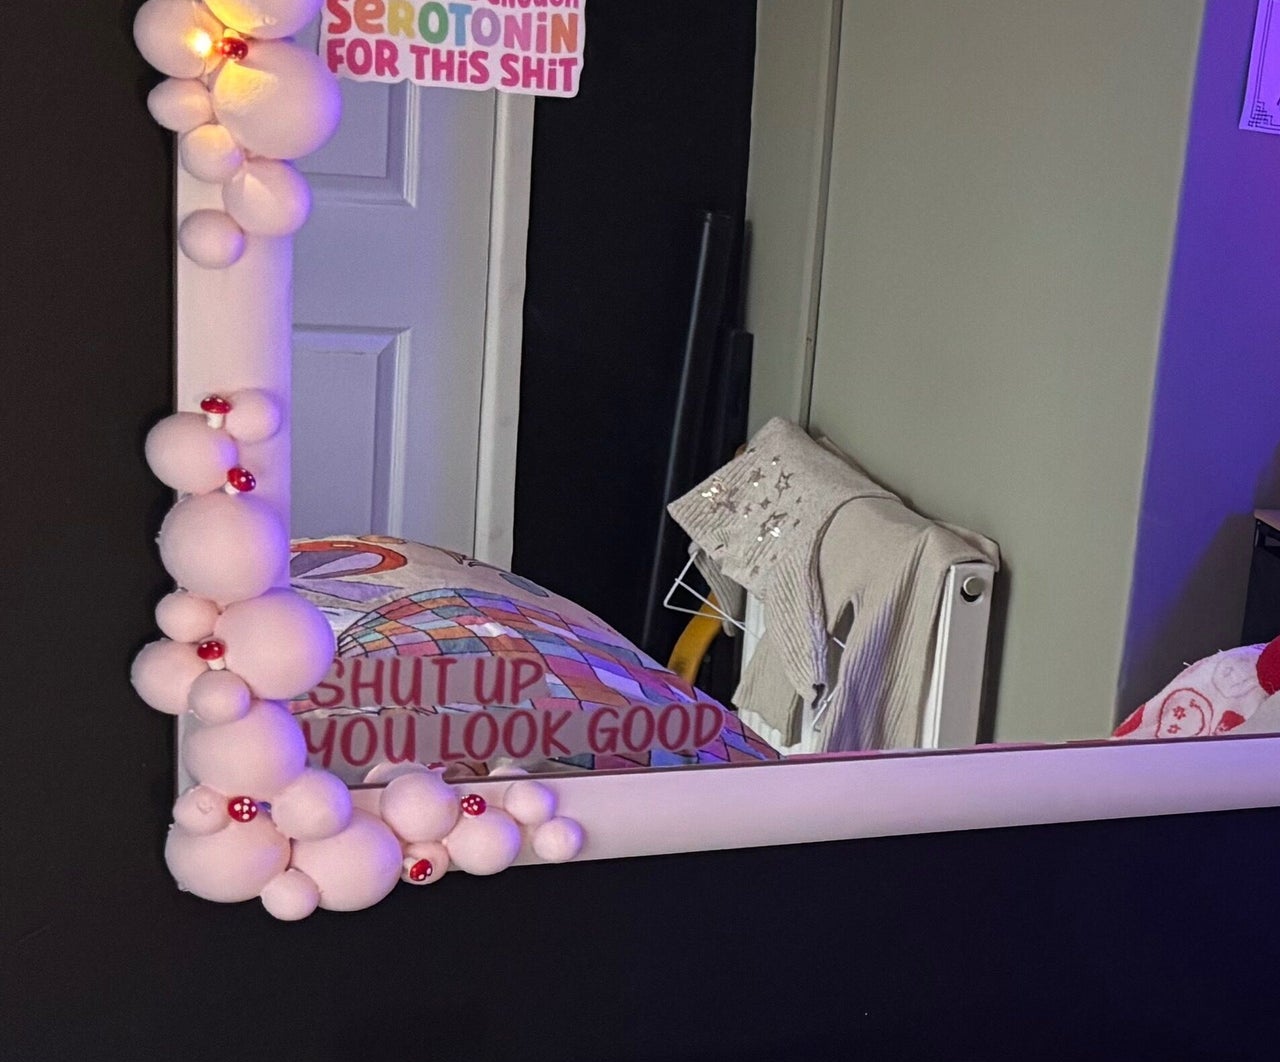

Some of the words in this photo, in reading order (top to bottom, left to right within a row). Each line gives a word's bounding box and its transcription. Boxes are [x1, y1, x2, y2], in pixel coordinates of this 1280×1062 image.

[327, 38, 399, 77] FOR
[310, 656, 458, 707] SHUT
[475, 656, 544, 705] UP
[302, 715, 418, 767] YOU
[440, 709, 575, 761] LOOK
[586, 703, 725, 755] GOOD
